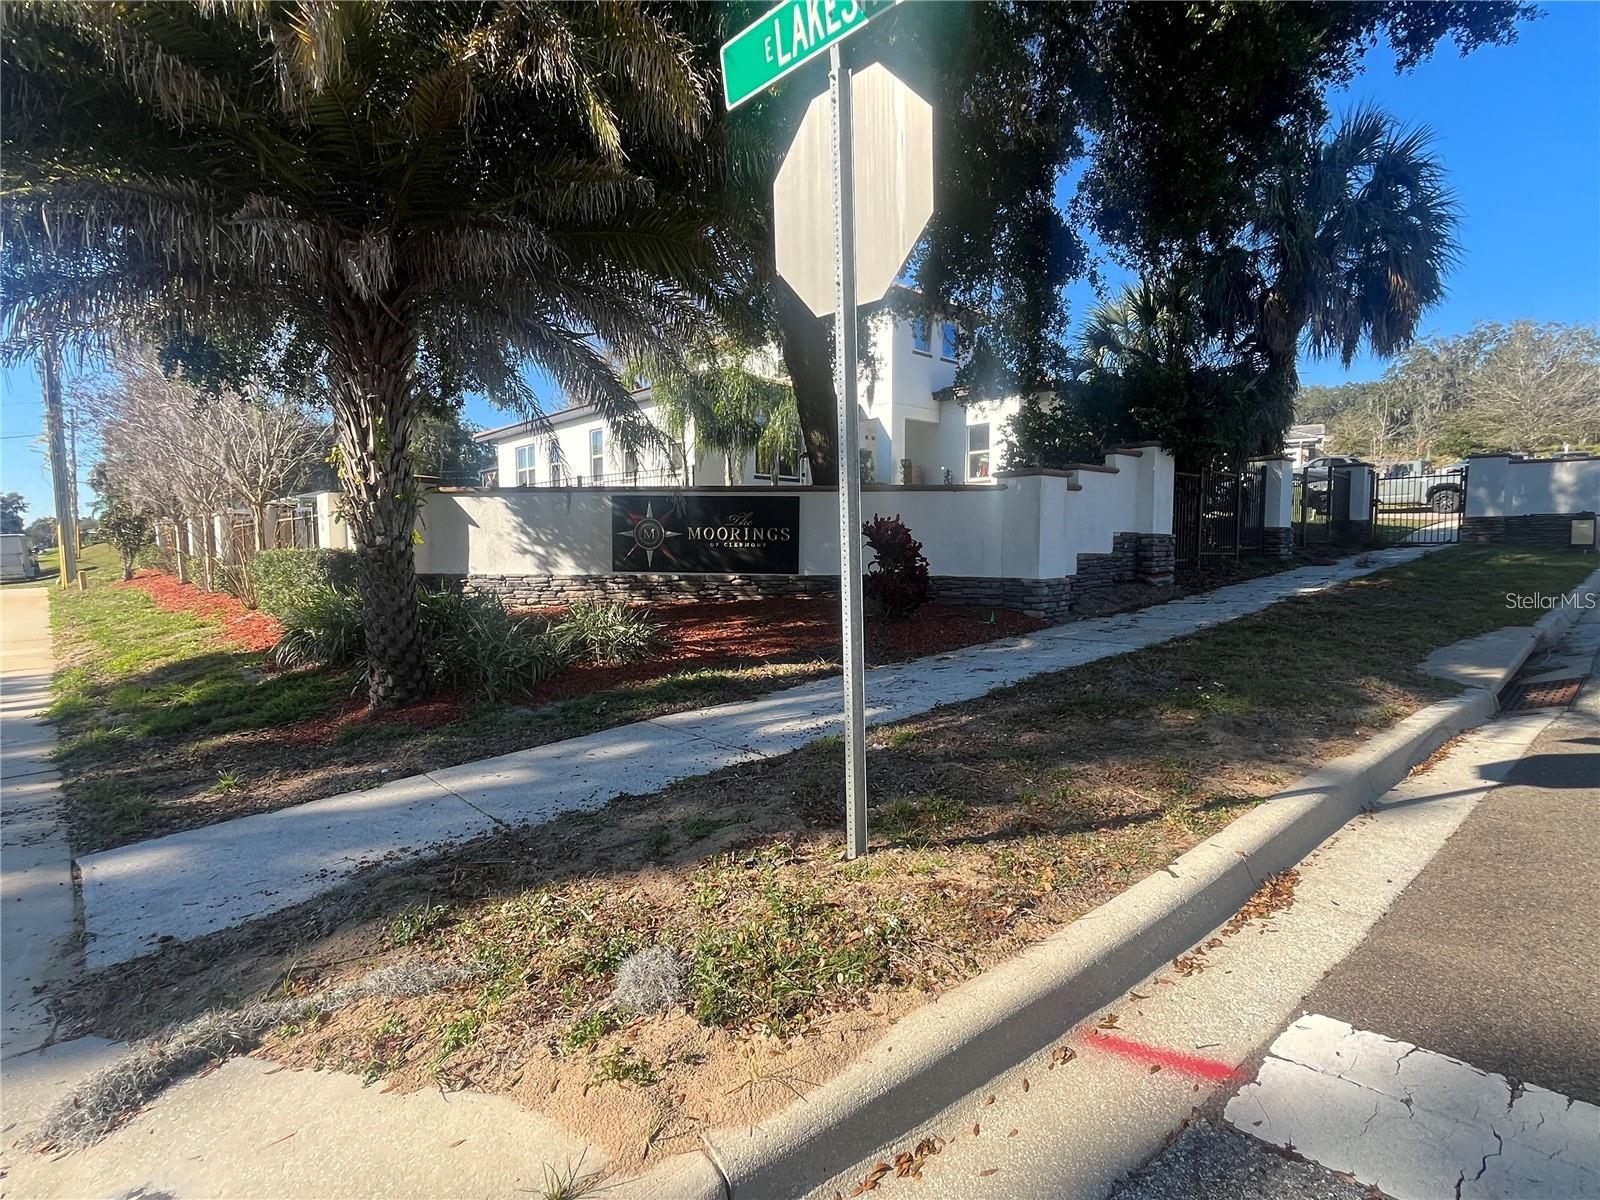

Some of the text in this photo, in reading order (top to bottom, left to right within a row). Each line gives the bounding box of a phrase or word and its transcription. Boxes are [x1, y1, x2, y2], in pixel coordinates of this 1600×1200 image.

[764, 35, 774, 63] E
[726, 512, 754, 526] The
[642, 528, 655, 540] M
[687, 526, 791, 541] MOORINGS
